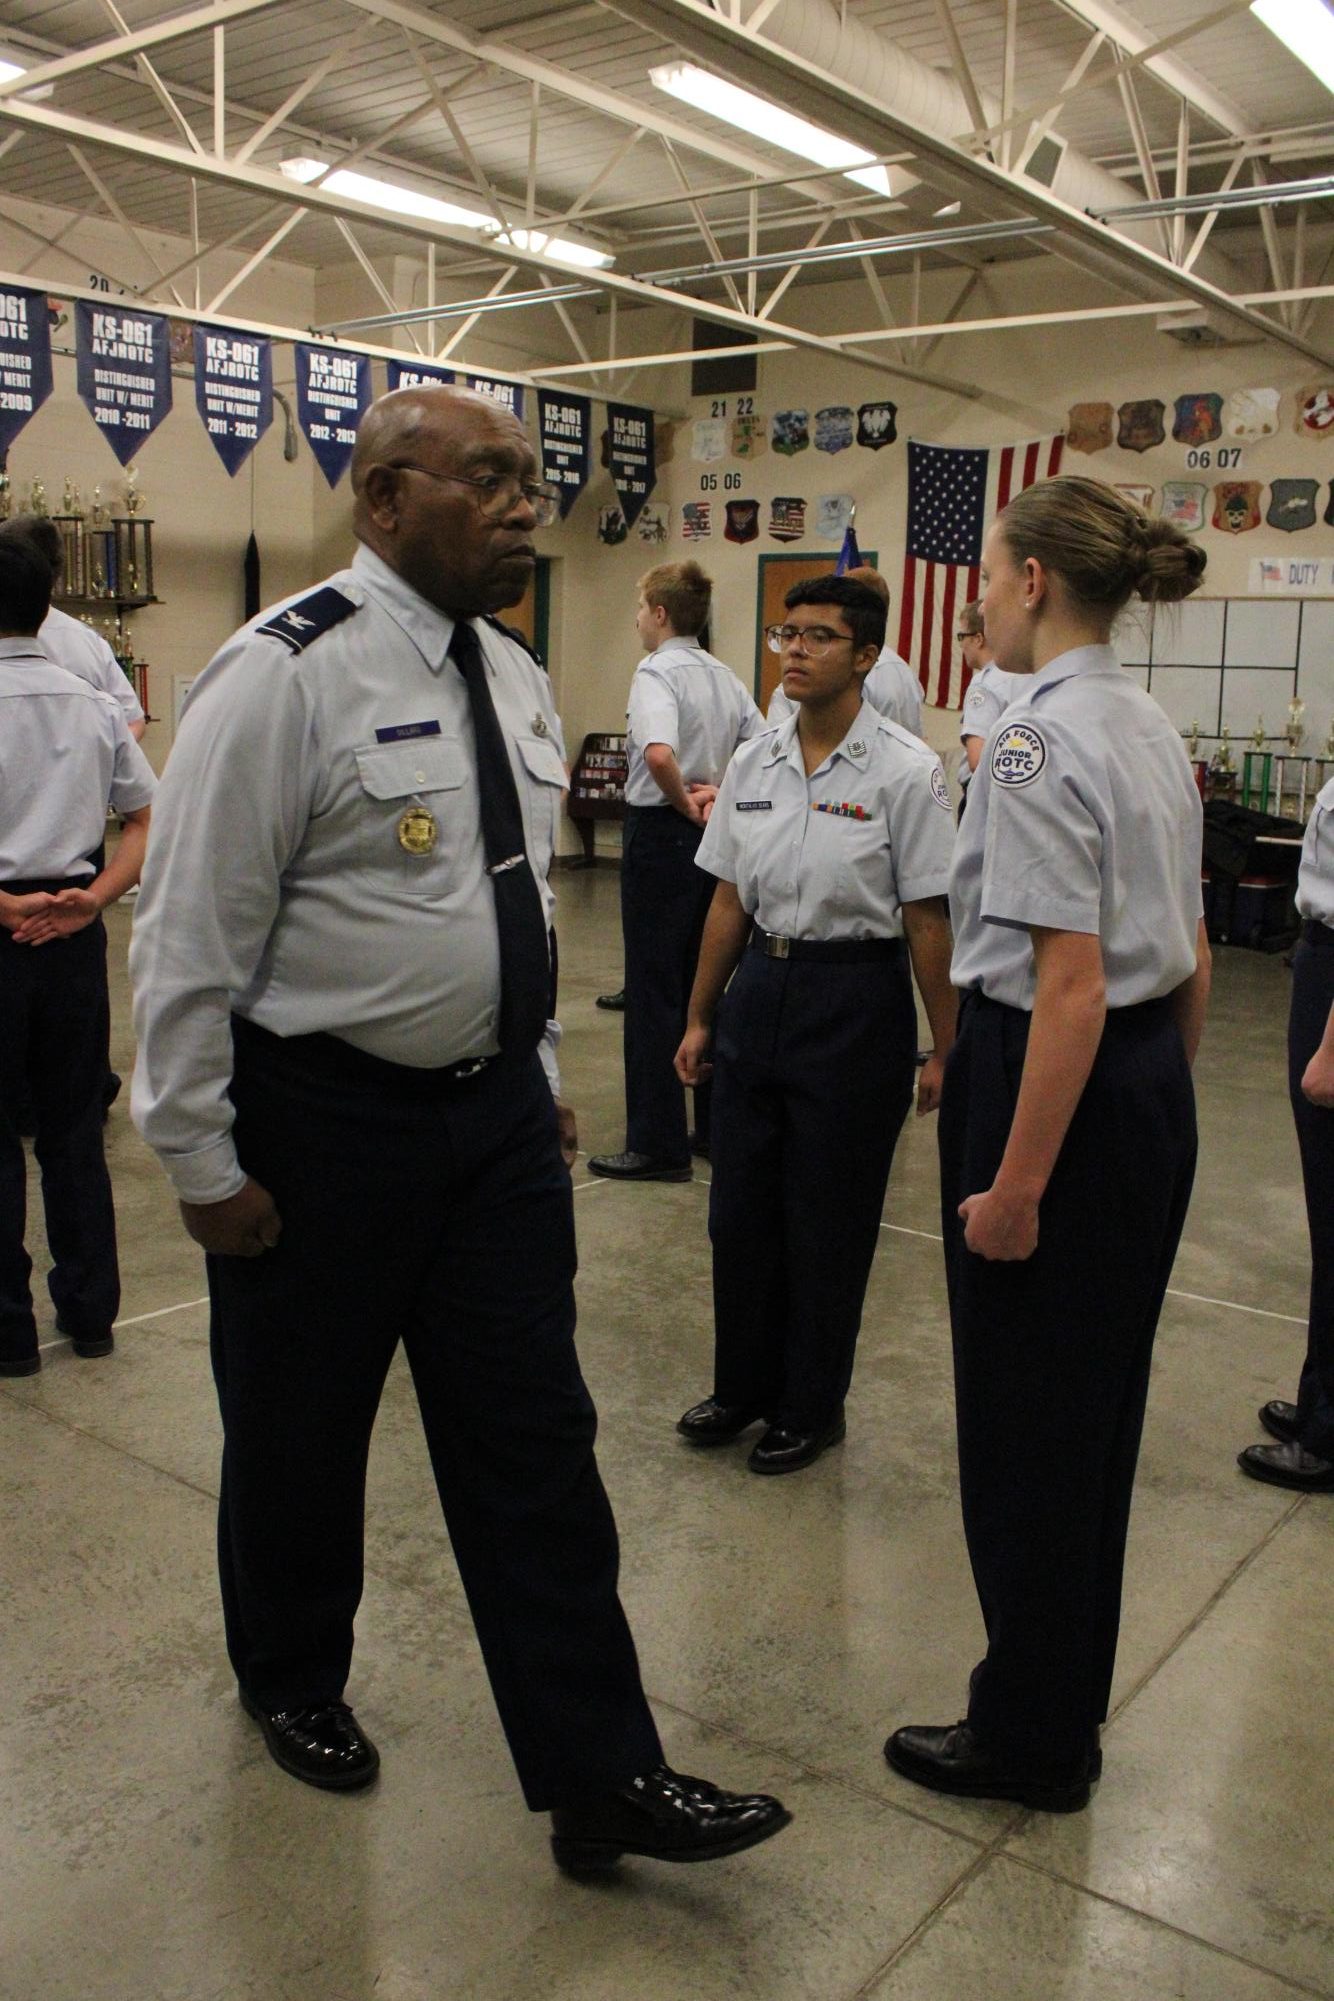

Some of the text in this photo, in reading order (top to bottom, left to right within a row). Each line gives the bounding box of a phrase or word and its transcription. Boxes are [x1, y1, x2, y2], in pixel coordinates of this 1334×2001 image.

[92, 312, 153, 347] KS-061
[92, 338, 154, 364] AFJROTC
[206, 336, 260, 366] KS-061
[206, 357, 259, 382] AFJROTC
[309, 352, 358, 380] KS-061
[94, 368, 155, 392] DISTINGUISHED
[308, 372, 357, 395] AFJROTC
[95, 386, 115, 403] UNIT
[130, 392, 155, 409] MERIT
[711, 397, 753, 418] 21 22
[94, 406, 120, 425] 2010
[544, 402, 582, 425] KS-061
[207, 417, 227, 435] 2011
[234, 421, 258, 439] 2012
[309, 423, 330, 441] 2012
[544, 419, 582, 438] AFJROTC
[613, 416, 646, 437] KS-061
[1187, 448, 1242, 468] 06 07
[700, 472, 742, 491] 05 06
[1289, 564, 1319, 584] DUTY
[998, 730, 1040, 752] AIR FORCE
[994, 757, 1034, 771] ROTC
[998, 749, 1032, 760] JUNIOR
